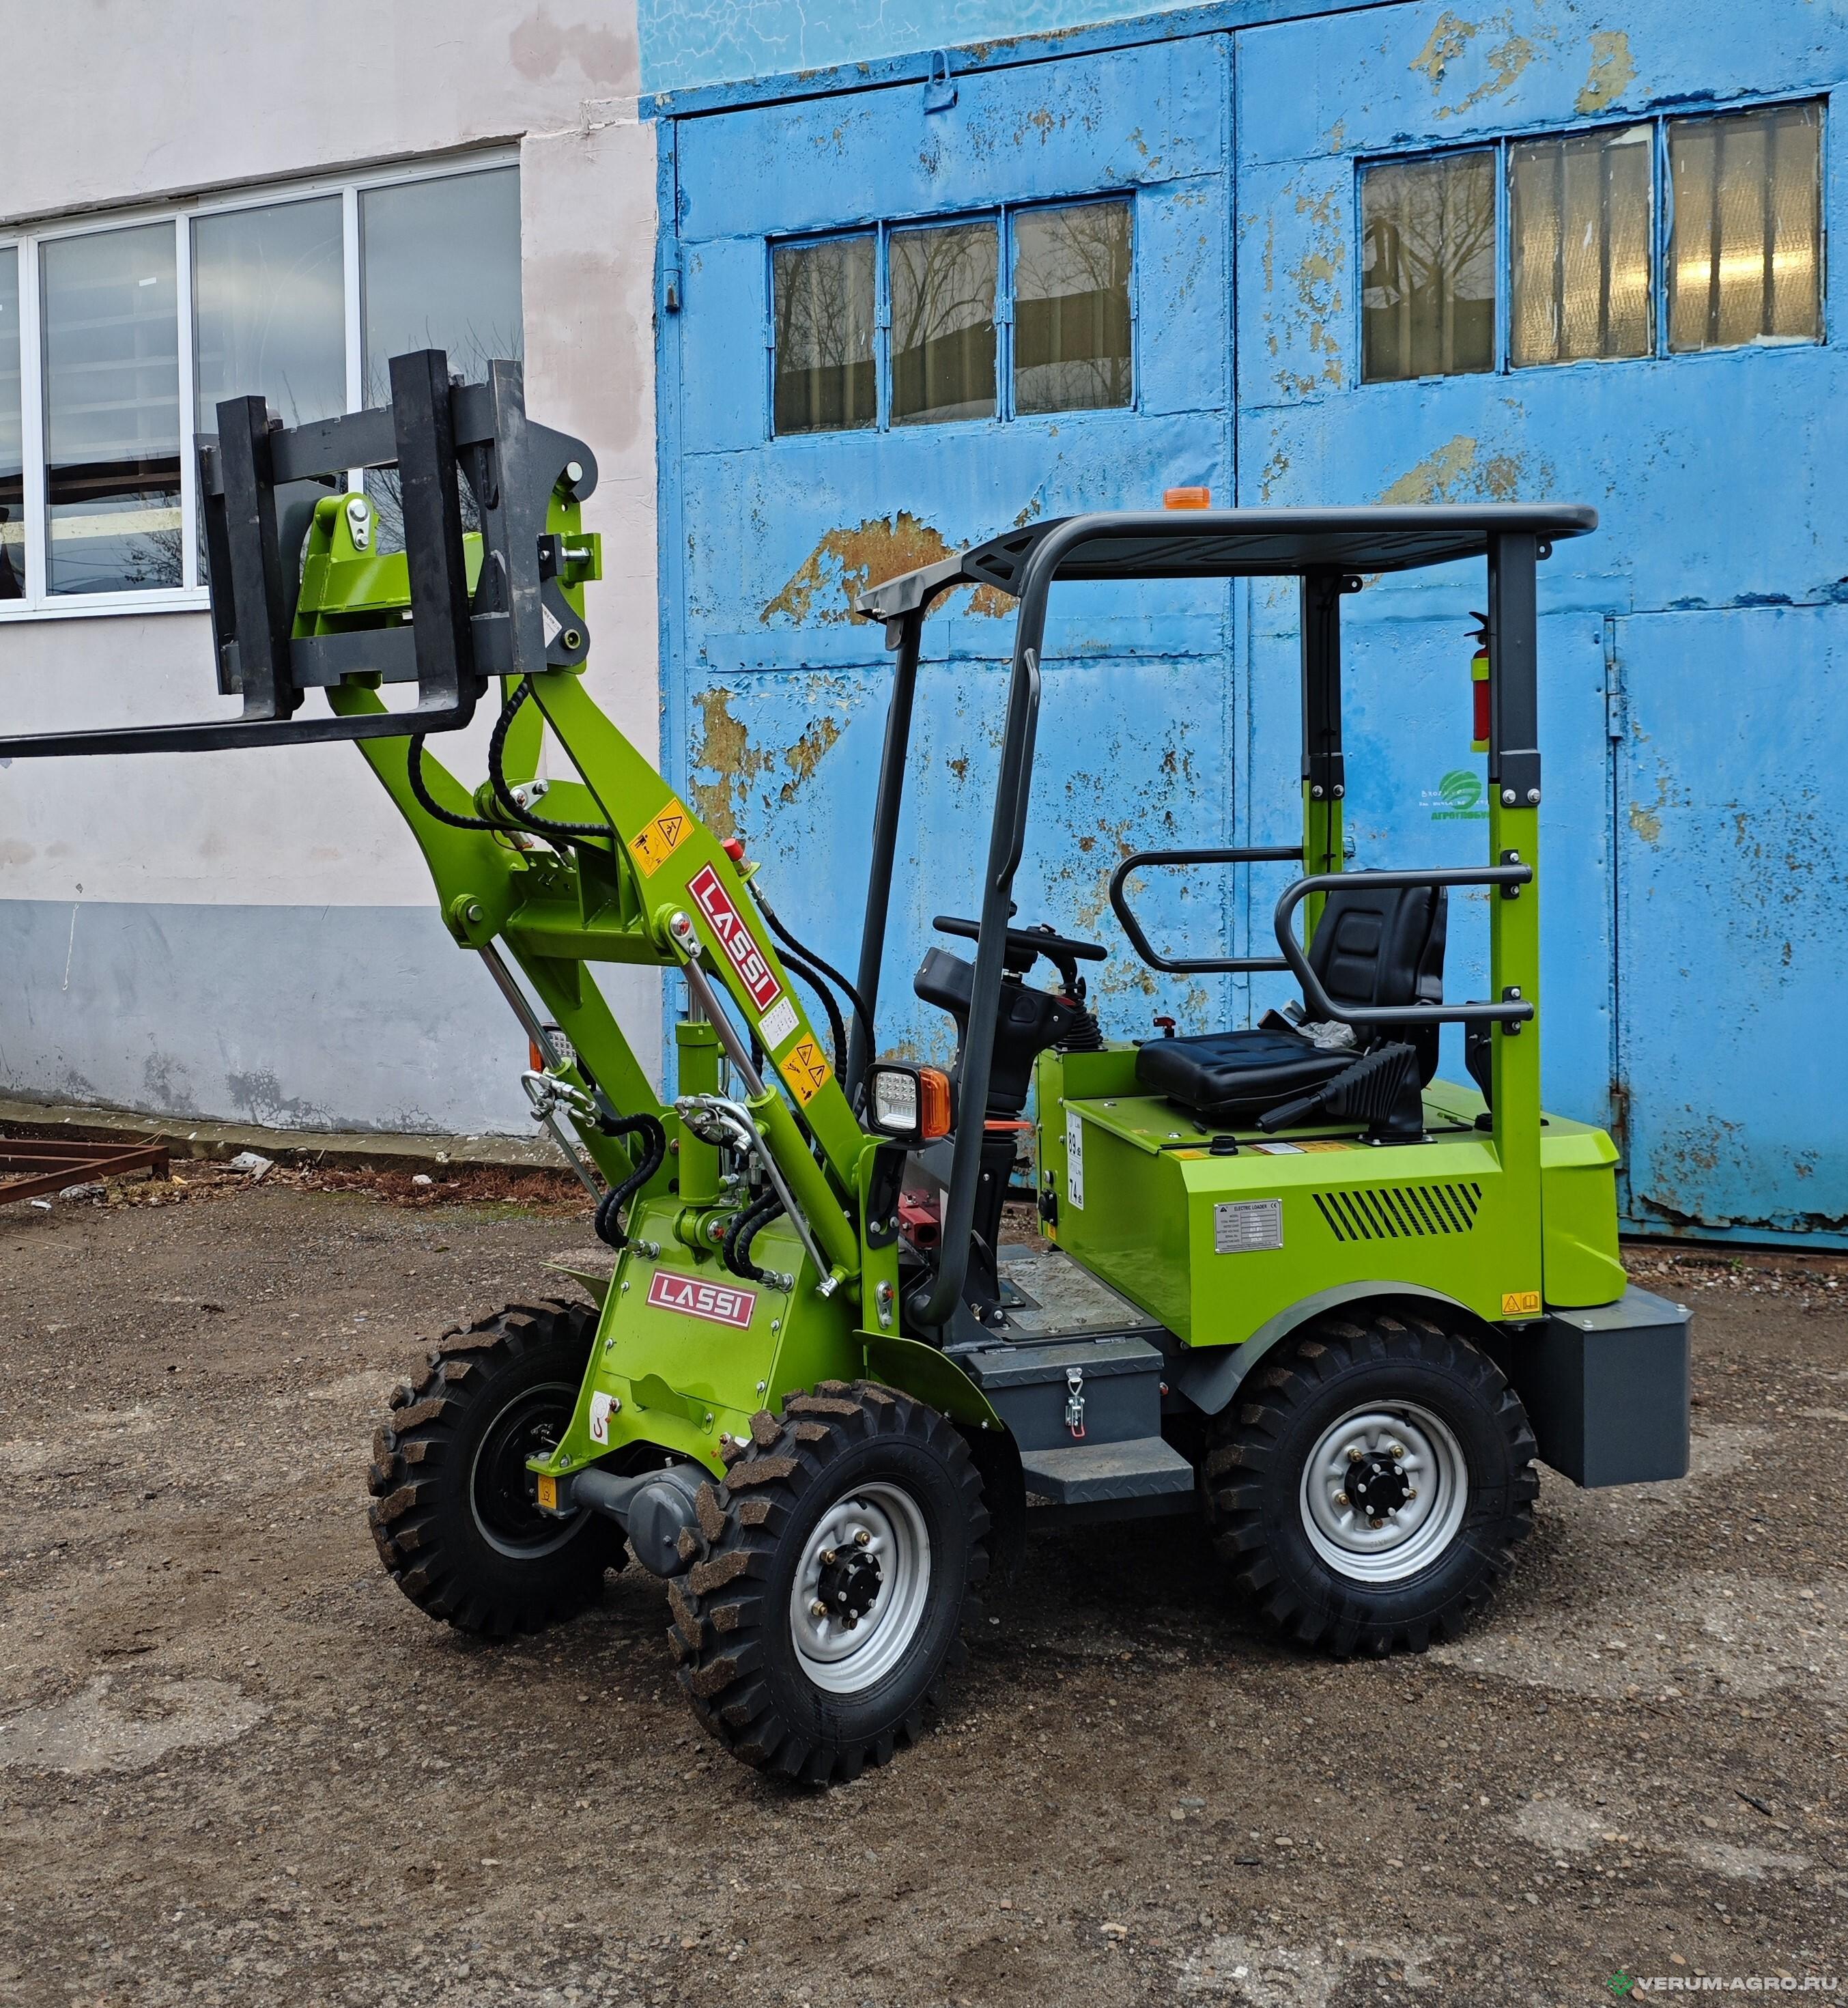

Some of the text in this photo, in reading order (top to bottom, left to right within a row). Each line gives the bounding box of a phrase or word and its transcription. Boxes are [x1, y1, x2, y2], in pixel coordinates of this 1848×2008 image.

[700, 882, 769, 993] LASSI
[1068, 1131, 1077, 1155] 89
[1077, 1147, 1081, 1157] dB
[1070, 1178, 1077, 1202] 74
[659, 1279, 742, 1318] LASSI
